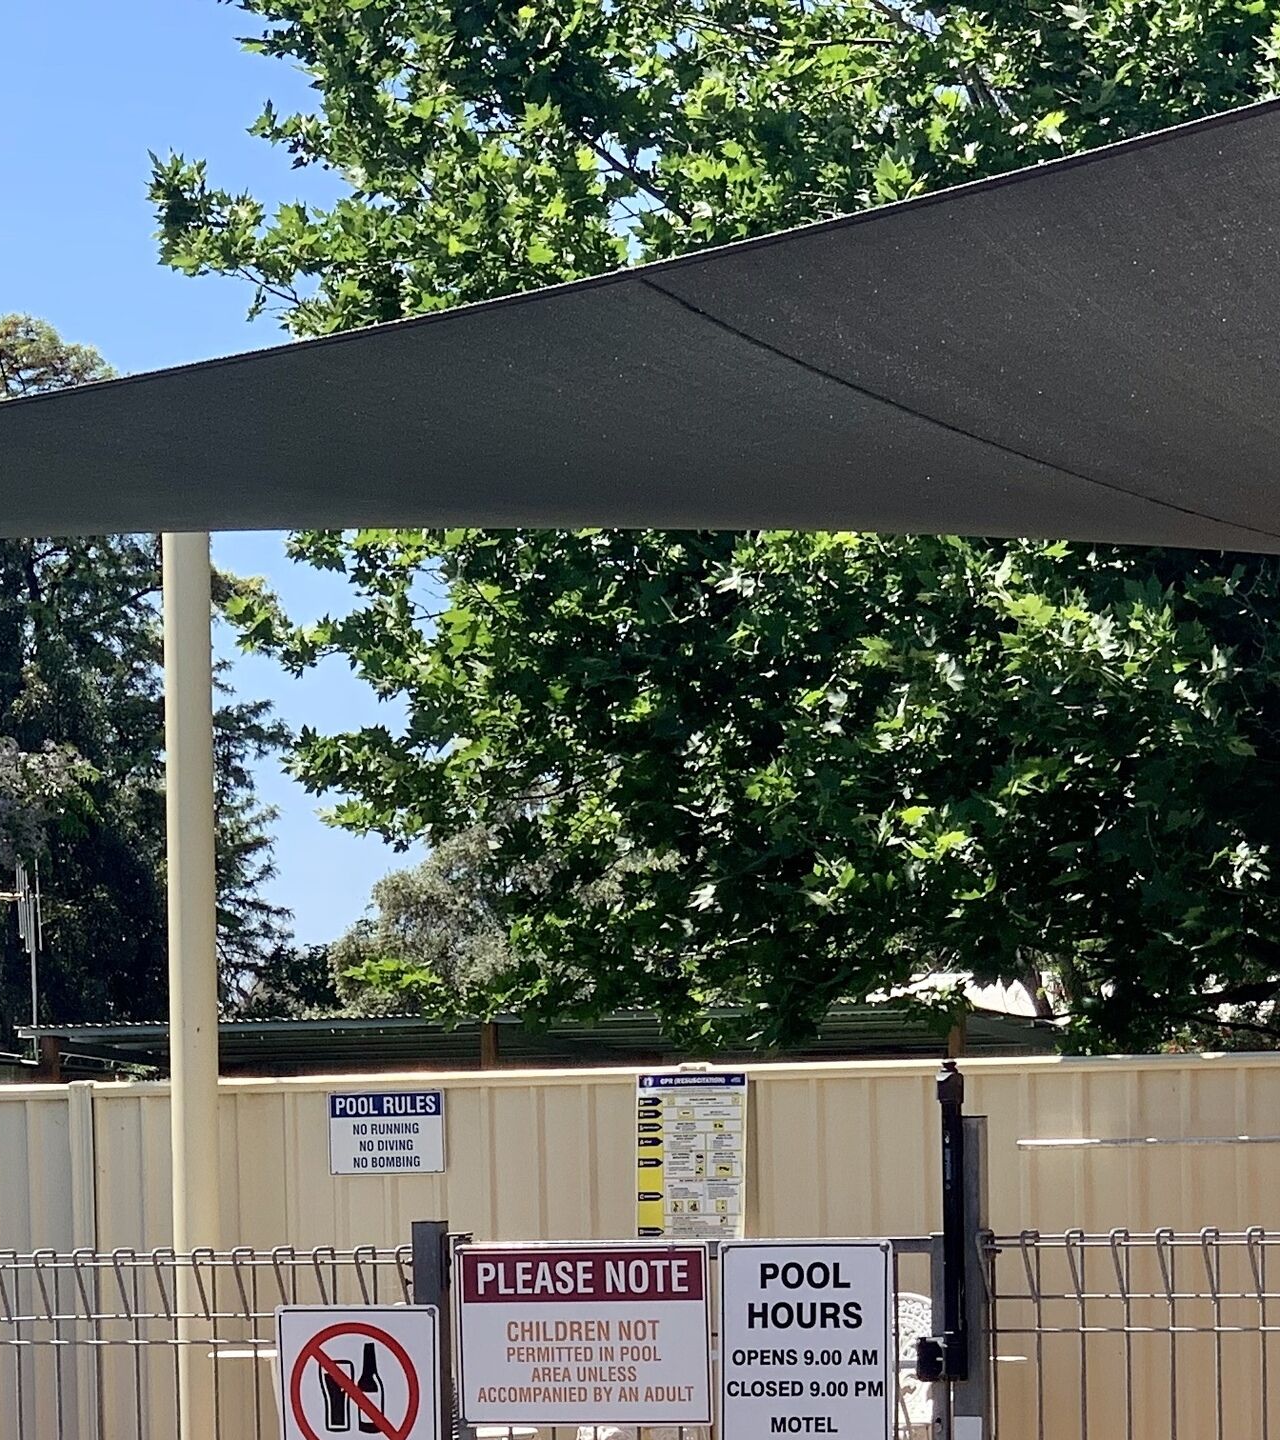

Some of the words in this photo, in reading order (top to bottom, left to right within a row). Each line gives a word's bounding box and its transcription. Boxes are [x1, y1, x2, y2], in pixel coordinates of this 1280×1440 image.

[335, 1097, 378, 1115] POOL
[383, 1095, 436, 1114] RULES
[353, 1124, 367, 1135] NO
[371, 1123, 419, 1135] RUNNING
[359, 1140, 374, 1152] NO
[377, 1139, 414, 1151] DIVING
[353, 1157, 368, 1168] NO
[371, 1156, 420, 1168] BOMBING
[477, 1260, 594, 1295] PLEASE
[606, 1259, 689, 1293] NOTE
[760, 1262, 851, 1289] POOL
[748, 1302, 863, 1329] HOURS
[507, 1320, 610, 1342] CHILDREN
[619, 1320, 660, 1341] NOT
[507, 1346, 594, 1363] PERMITTED
[599, 1346, 614, 1362] IN
[620, 1346, 662, 1362] POOL
[732, 1350, 798, 1366] OPENS
[803, 1350, 842, 1366] 9.00
[847, 1350, 878, 1366] AM
[531, 1367, 572, 1382] AREA
[577, 1366, 637, 1382] UNLESS
[477, 1387, 588, 1403] ACCOMPANIED
[594, 1387, 613, 1402] BY
[618, 1386, 639, 1402] AN
[644, 1386, 694, 1402] ADULT
[727, 1381, 804, 1397] CLOSED
[809, 1381, 848, 1397] 9.00
[854, 1381, 884, 1397] PM
[771, 1417, 838, 1433] MOTEL
